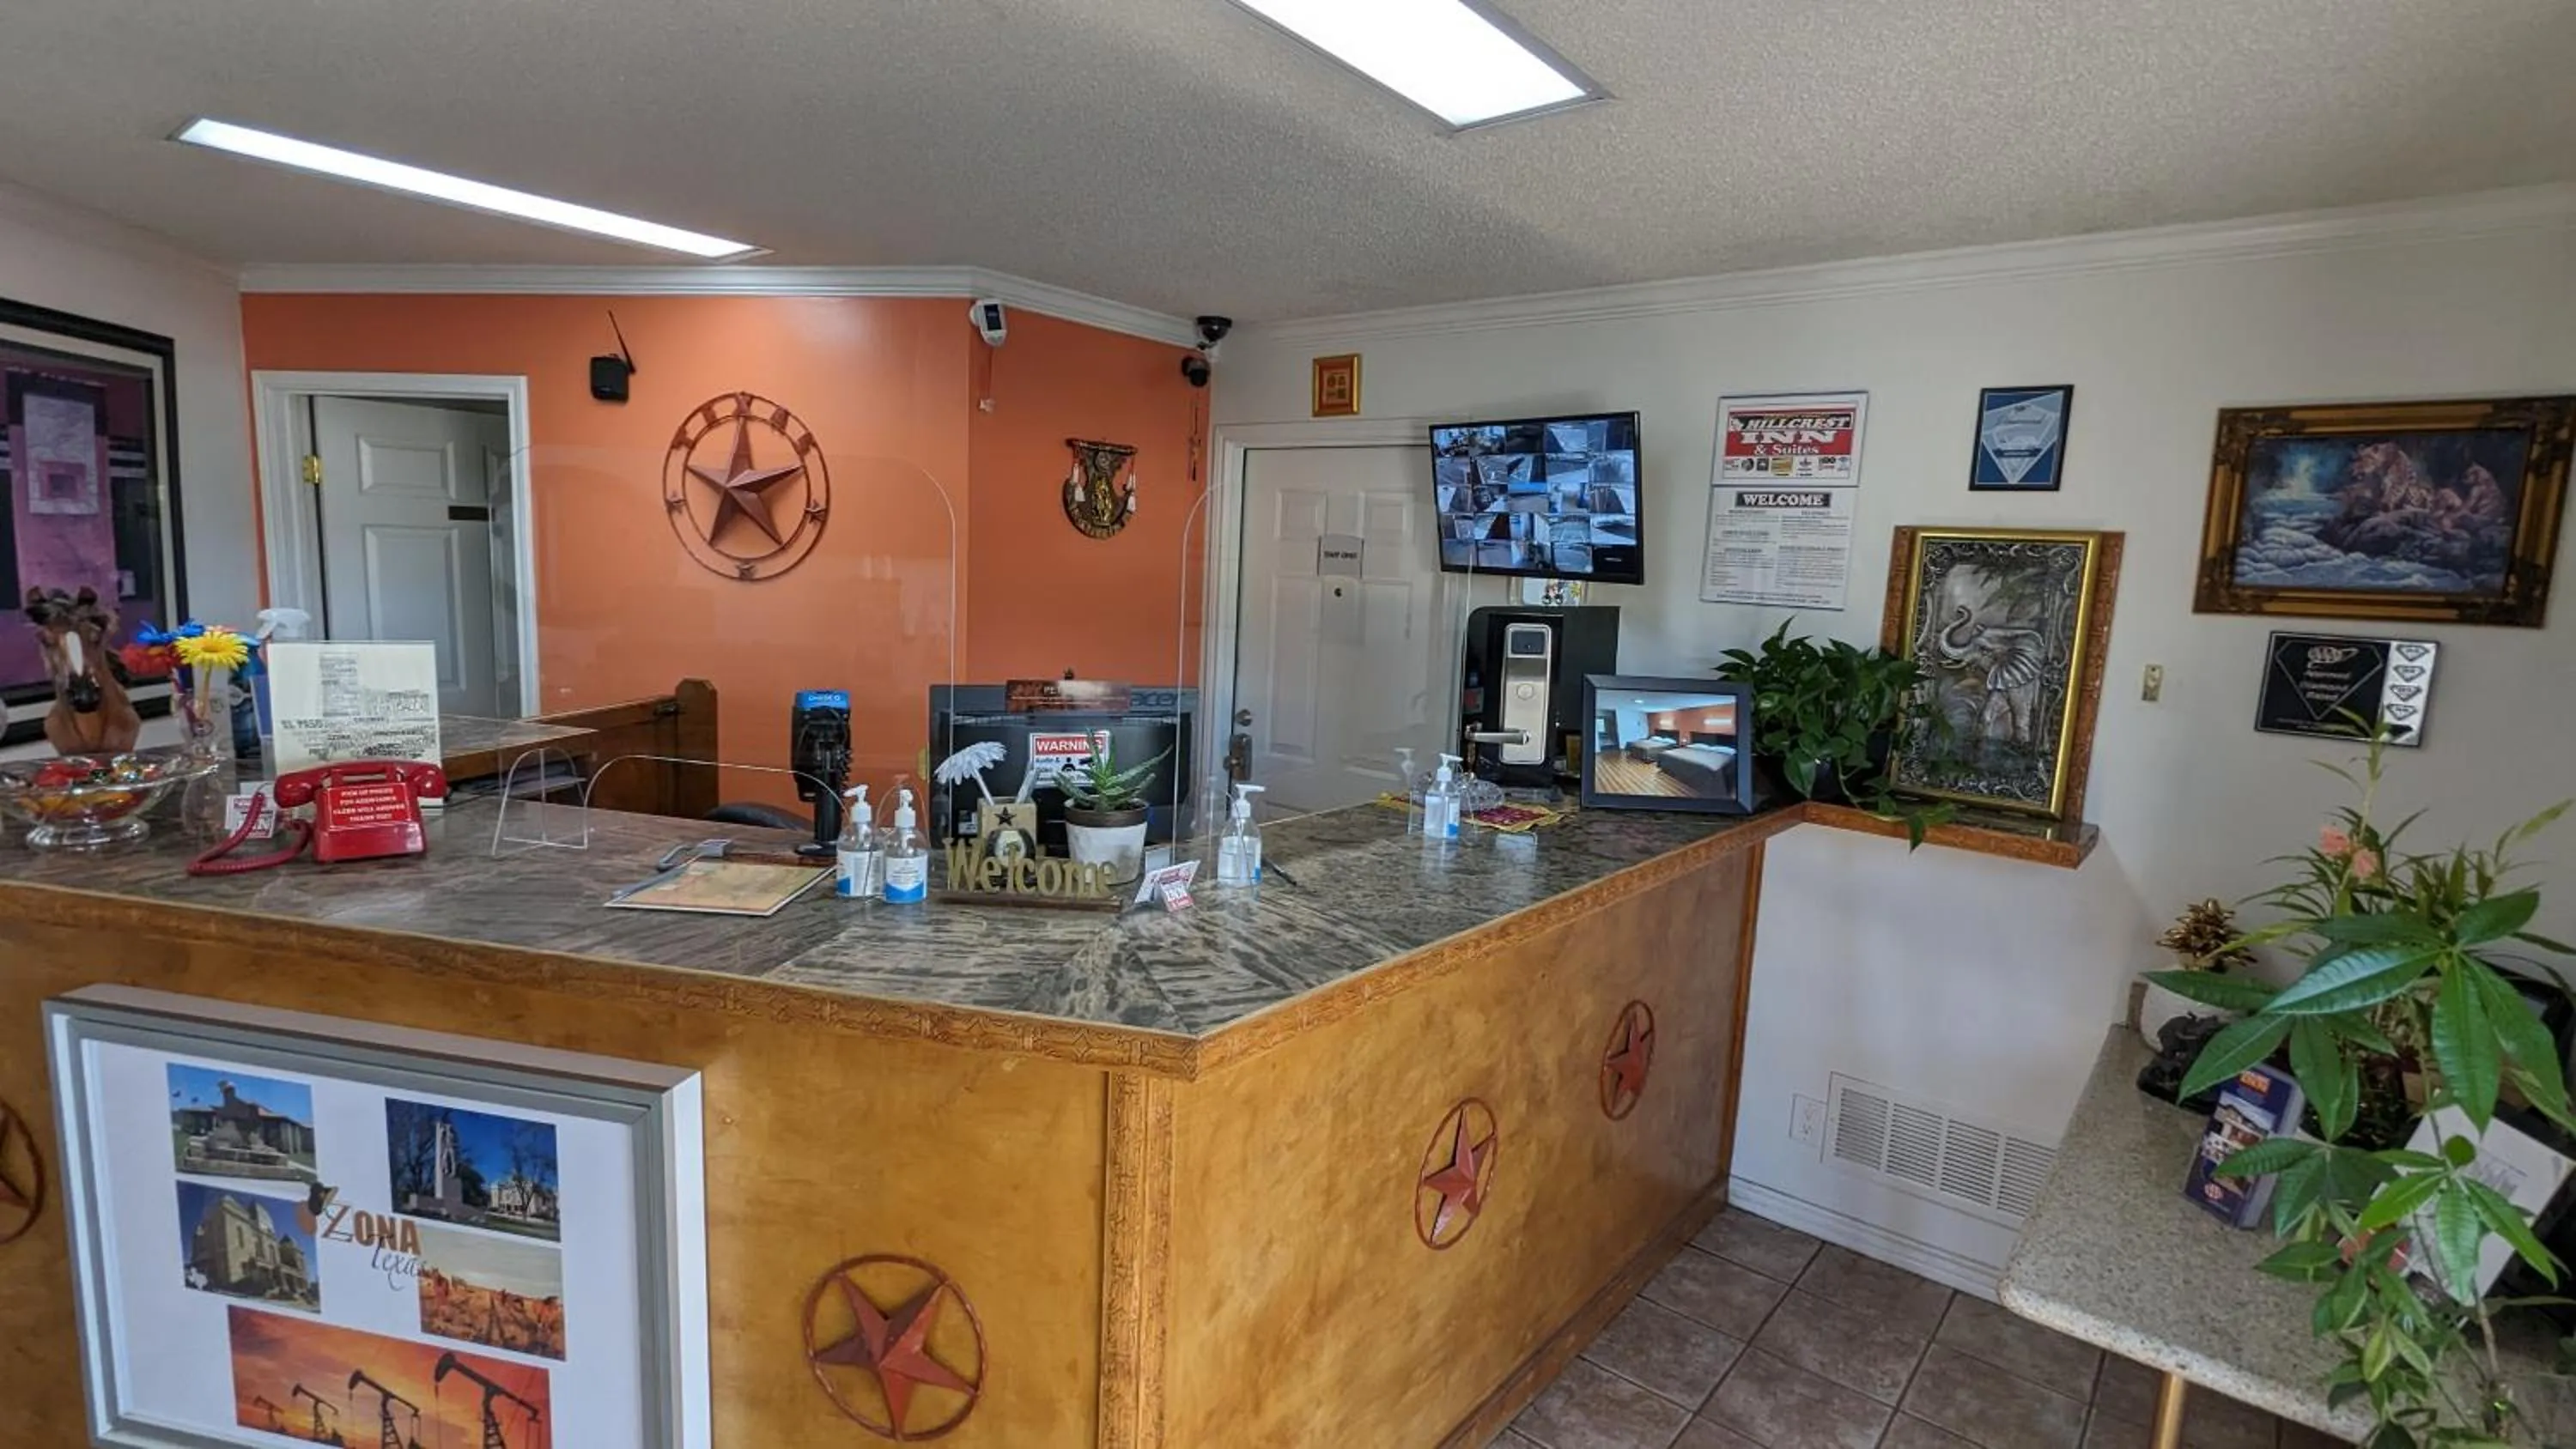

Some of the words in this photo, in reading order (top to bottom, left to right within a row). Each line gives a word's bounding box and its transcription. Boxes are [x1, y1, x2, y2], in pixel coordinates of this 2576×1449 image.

[1746, 416, 1850, 430] HILLCREST
[1741, 430, 1838, 444] INN
[1754, 444, 1766, 455] &
[1771, 443, 1820, 455] Suites
[1741, 493, 1824, 506] WELCOME
[1130, 692, 1179, 706] acer
[943, 837, 1118, 897] Welcome
[367, 1234, 427, 1292] Texas
